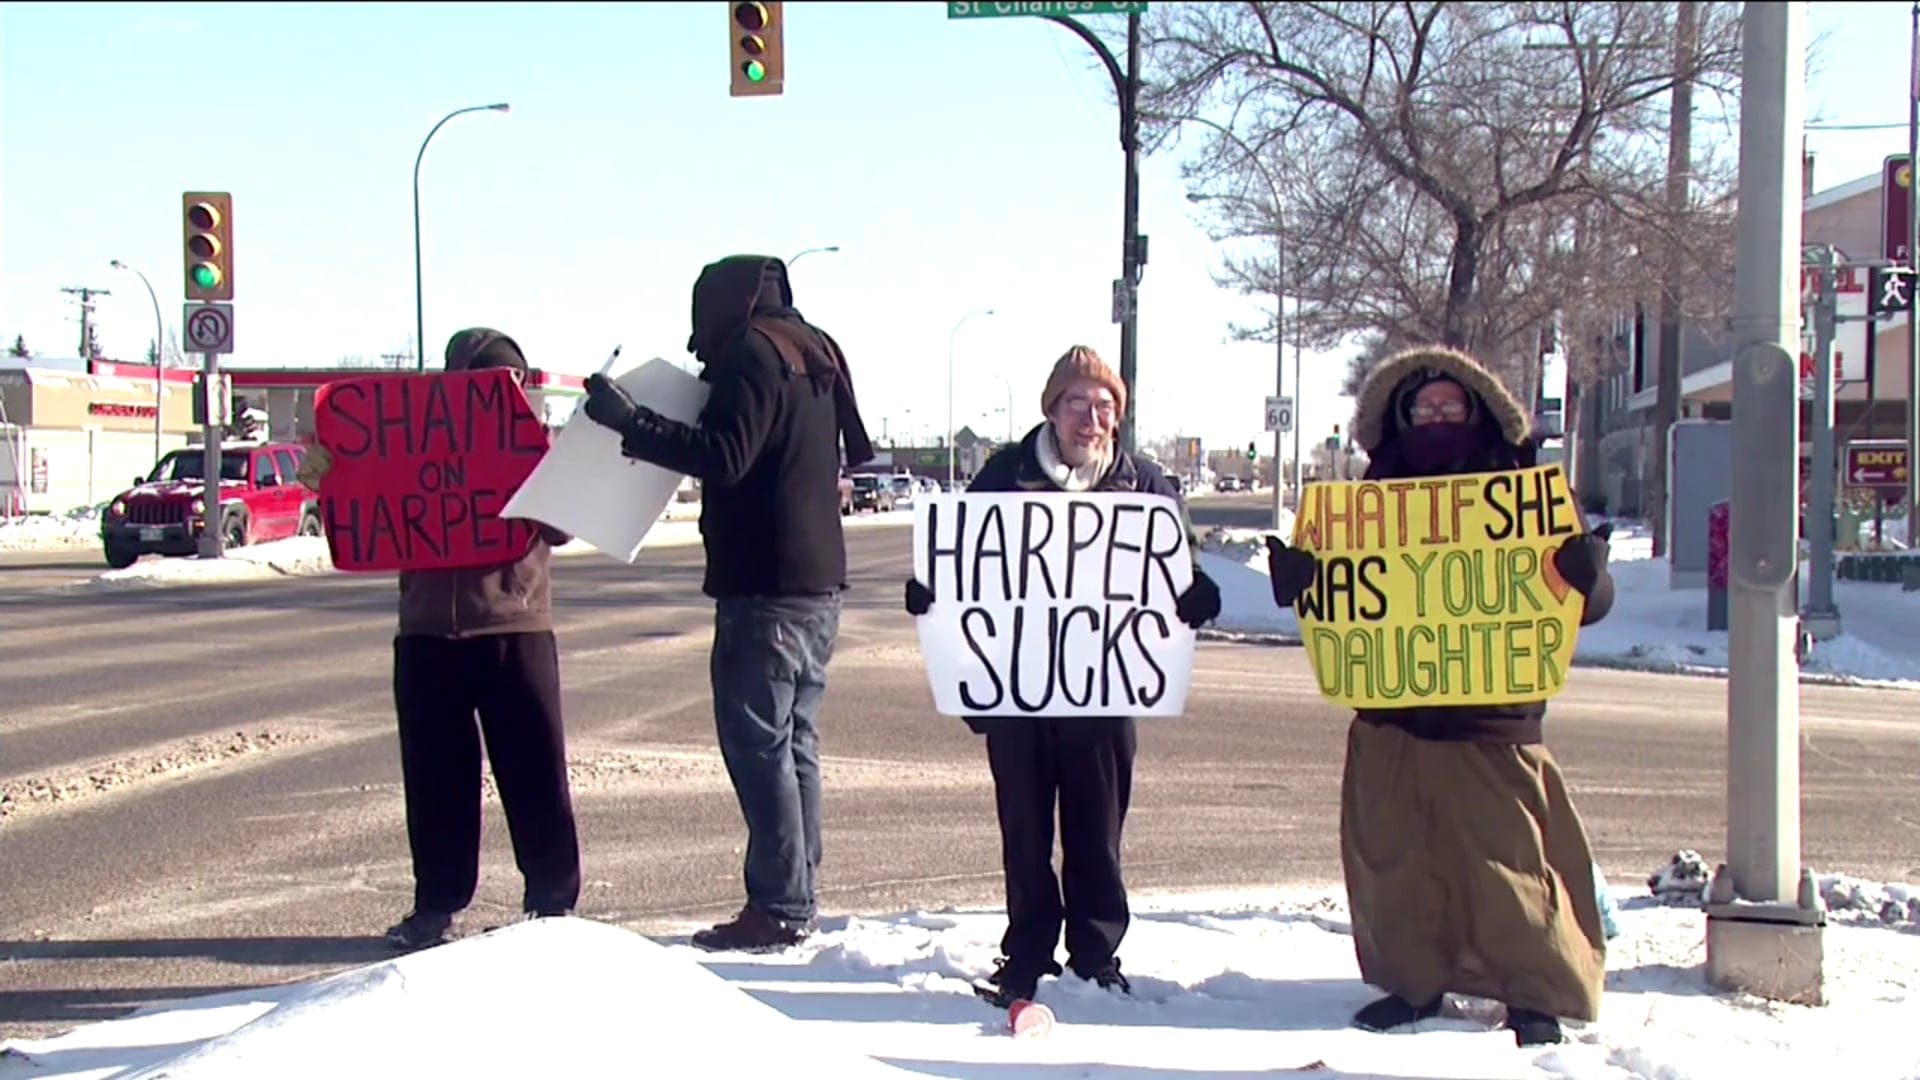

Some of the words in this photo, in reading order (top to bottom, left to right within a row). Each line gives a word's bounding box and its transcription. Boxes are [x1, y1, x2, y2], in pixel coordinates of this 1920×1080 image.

[328, 374, 546, 458] SHAME
[1268, 408, 1290, 427] 60
[418, 456, 464, 493] ON
[1857, 452, 1905, 465] EXIT
[1296, 482, 1416, 551] WHAT
[1420, 479, 1479, 545] IF
[1483, 467, 1574, 540] SHE
[928, 501, 1182, 606] HARPER
[1299, 556, 1388, 622] WAS
[1401, 546, 1543, 617] YOUR
[959, 603, 1170, 712] SUCKS
[1313, 617, 1564, 698] DAUGHTER
